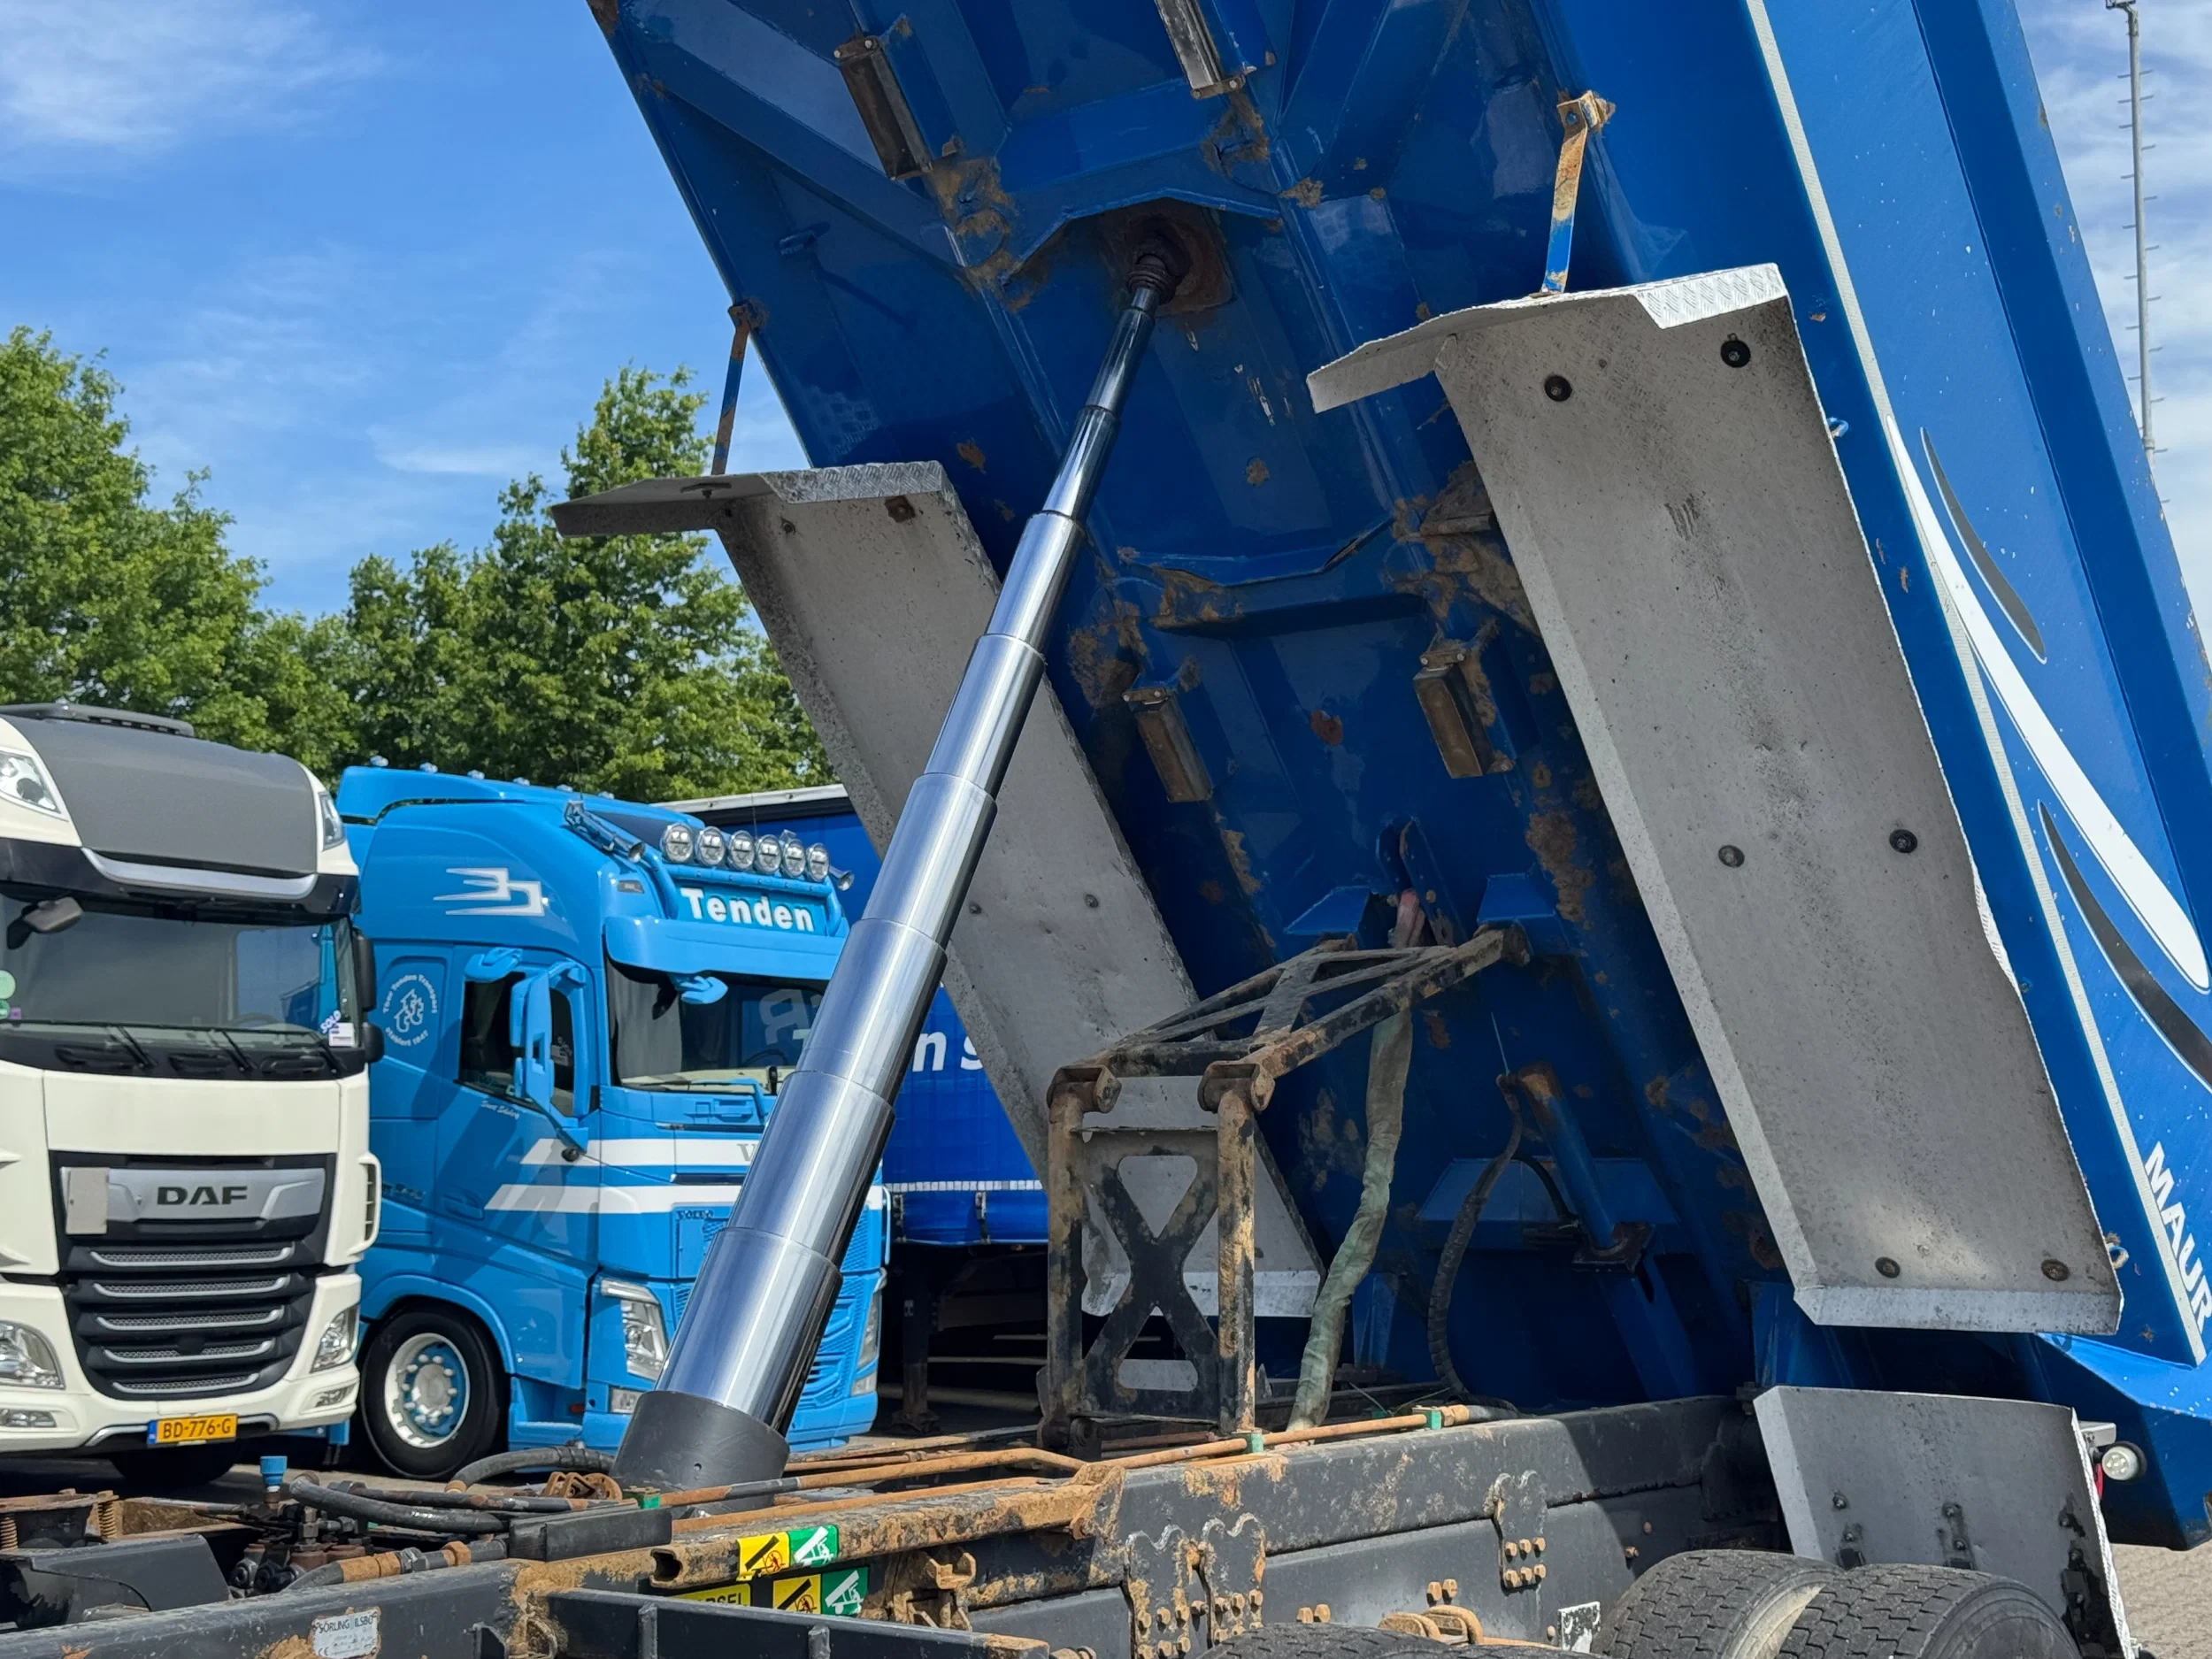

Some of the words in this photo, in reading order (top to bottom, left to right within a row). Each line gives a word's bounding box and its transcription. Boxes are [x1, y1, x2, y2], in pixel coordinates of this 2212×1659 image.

[680, 887, 814, 932] Tenden
[157, 1187, 248, 1205] DAF
[163, 1417, 232, 1440] BD-776-G
